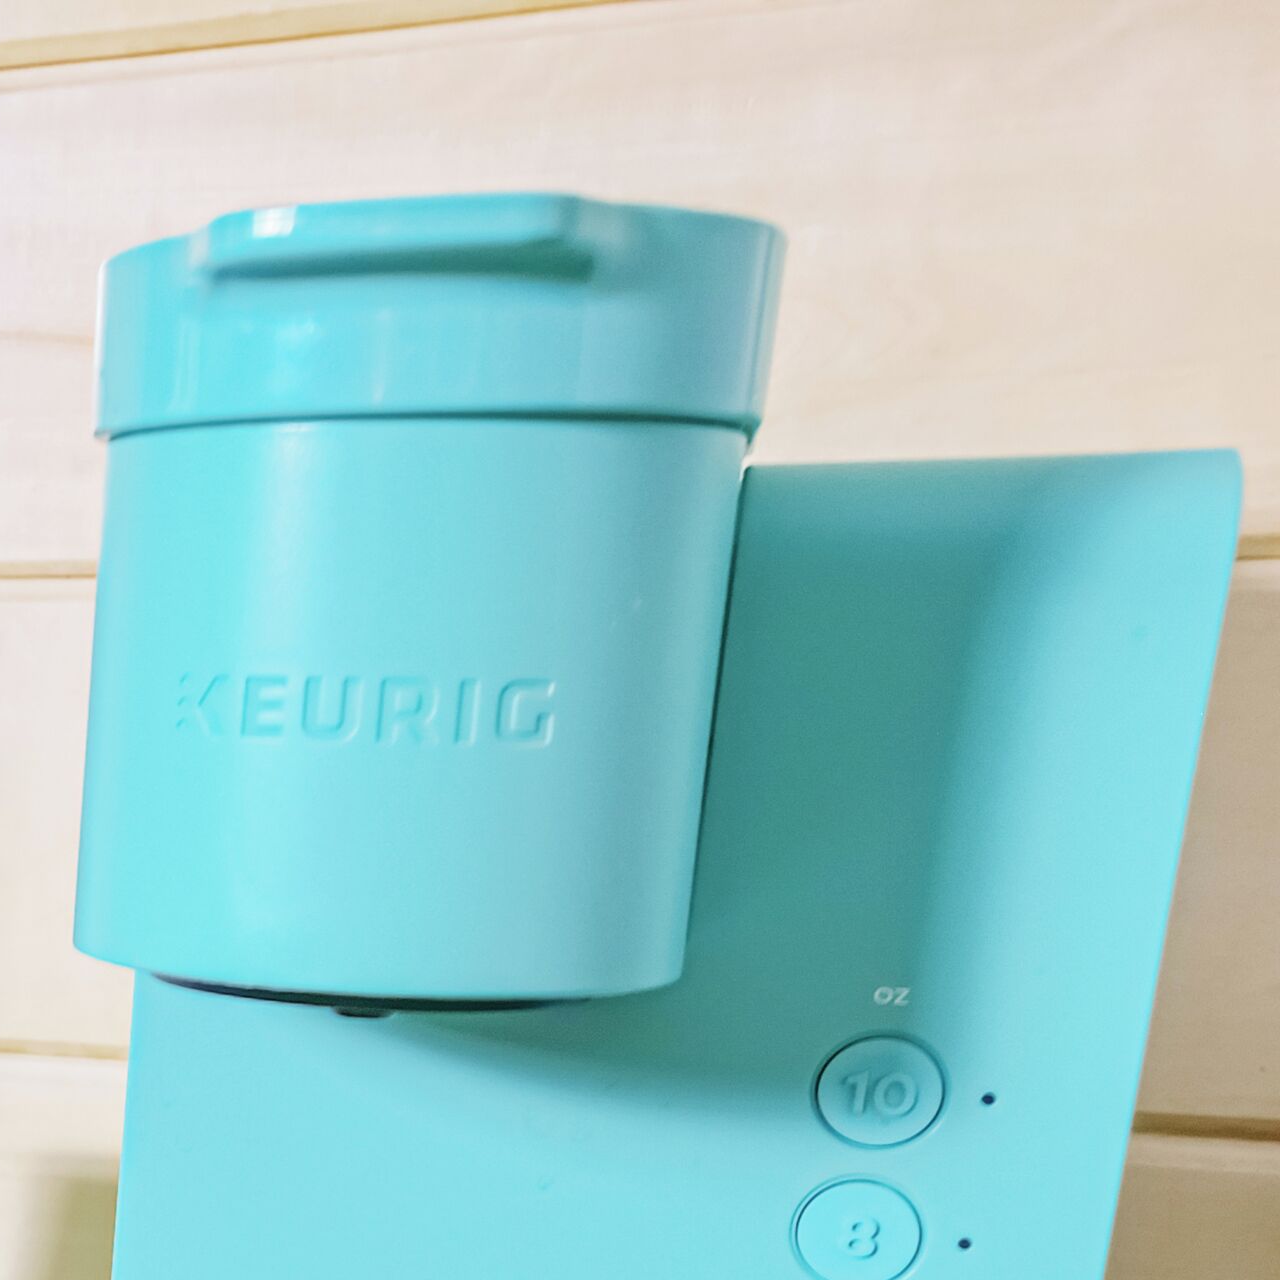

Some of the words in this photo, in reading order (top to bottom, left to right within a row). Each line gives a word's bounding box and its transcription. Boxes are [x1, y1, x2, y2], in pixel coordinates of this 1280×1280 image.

[176, 671, 557, 748] KEURIG
[840, 1068, 920, 1118] 10
[844, 1215, 881, 1261] 8
